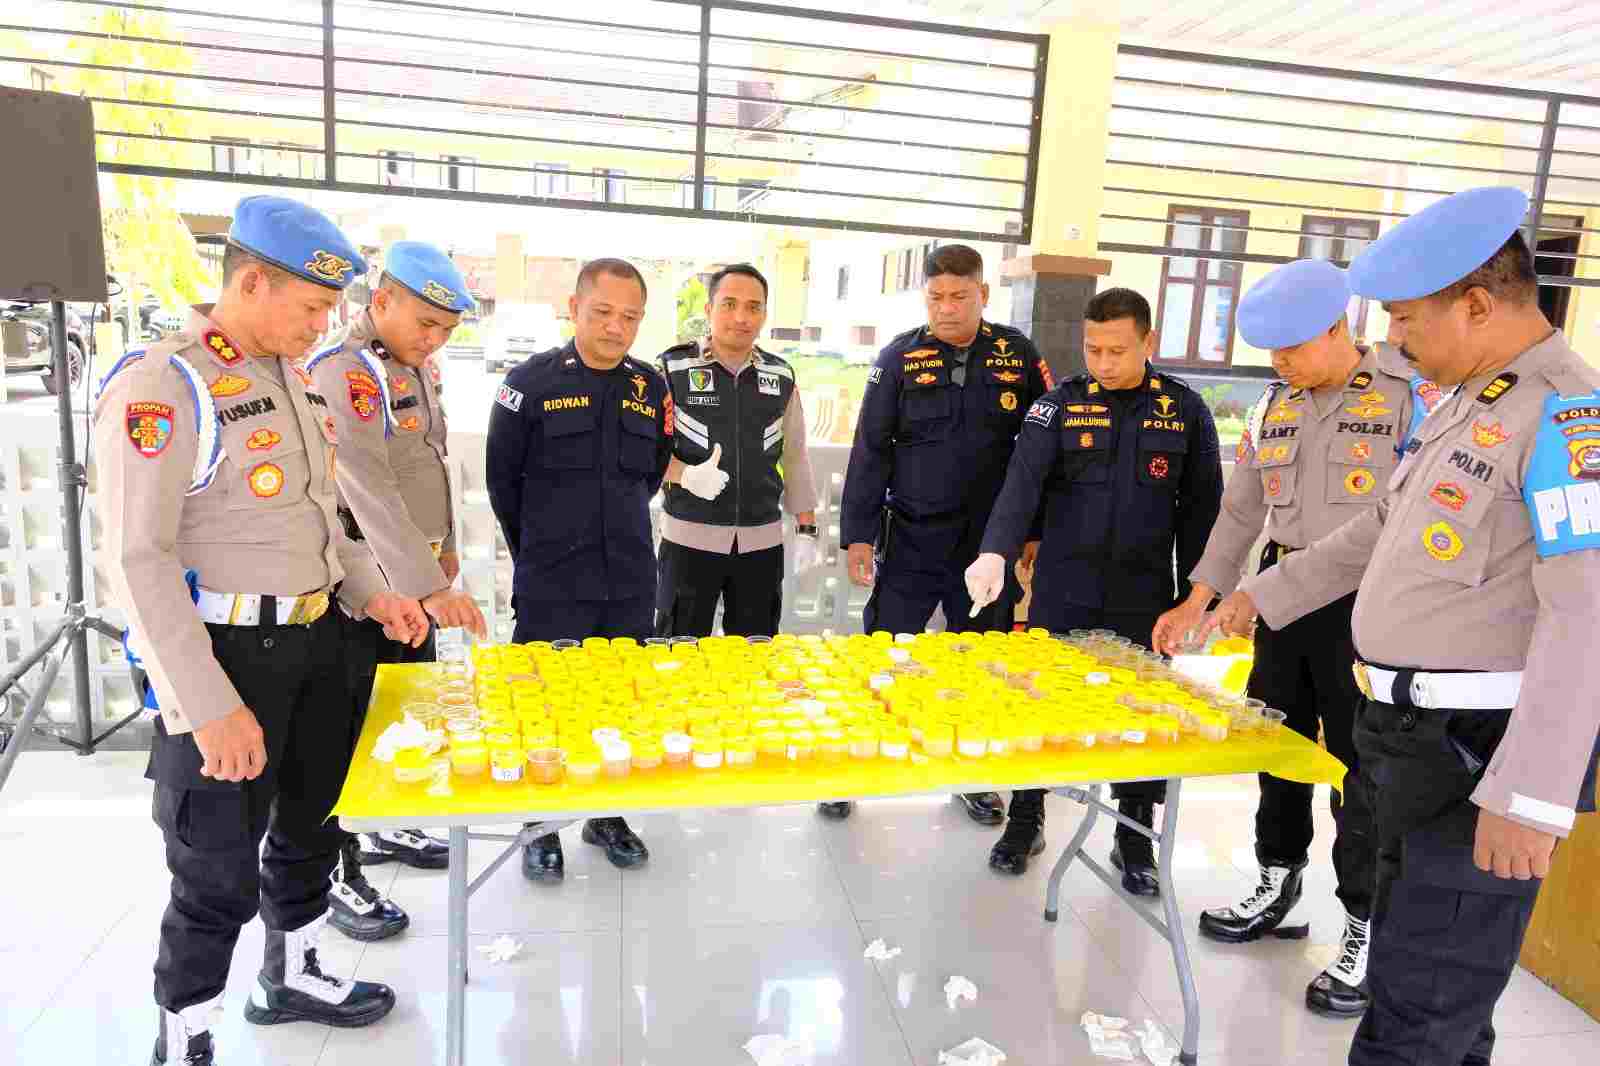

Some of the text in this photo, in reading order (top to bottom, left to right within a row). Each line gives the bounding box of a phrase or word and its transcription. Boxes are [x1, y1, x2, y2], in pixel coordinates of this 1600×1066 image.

[986, 359, 1023, 368] POLRI
[544, 396, 589, 412] RIDWAN
[622, 400, 656, 417] POLRI
[1559, 408, 1600, 421] POLD
[1143, 419, 1184, 431] POLRI
[1337, 422, 1393, 436] POLRI
[1448, 450, 1494, 482] POLRI
